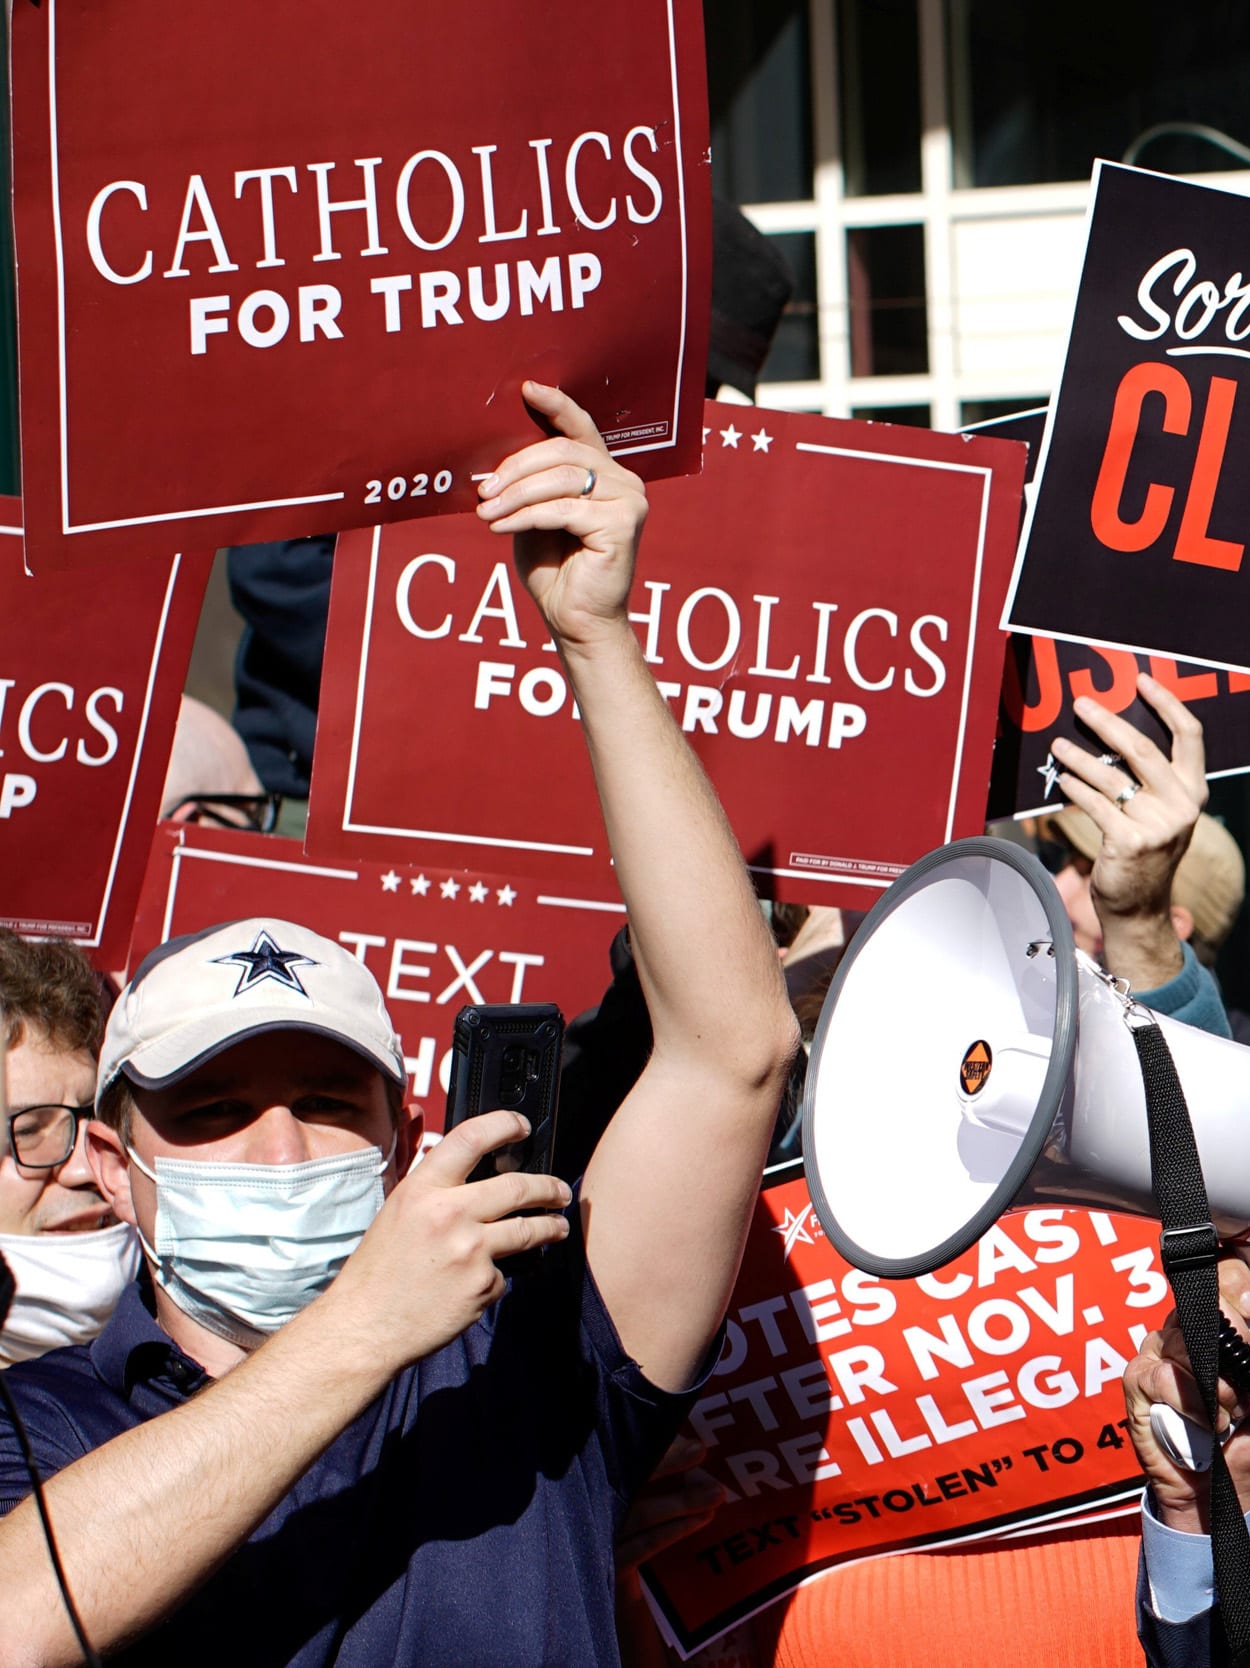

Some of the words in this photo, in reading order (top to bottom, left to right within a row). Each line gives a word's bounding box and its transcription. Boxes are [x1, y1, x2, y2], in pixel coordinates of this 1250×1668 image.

[86, 125, 663, 285] CATHOLICS
[190, 284, 344, 355] FOR
[370, 252, 602, 333] TRUMP
[364, 470, 452, 504] 2020
[395, 553, 949, 697] CAHOLICS
[474, 660, 581, 721] FO
[339, 931, 544, 1005] TEXT
[688, 1344, 897, 1447] FTER
[902, 1272, 1104, 1380] NOV.
[1111, 1246, 1168, 1308] 3
[711, 1268, 897, 1376] OTES
[696, 1515, 800, 1576] TEXT
[811, 1457, 1013, 1525] “STOLEN”
[1023, 1437, 1084, 1473] TO
